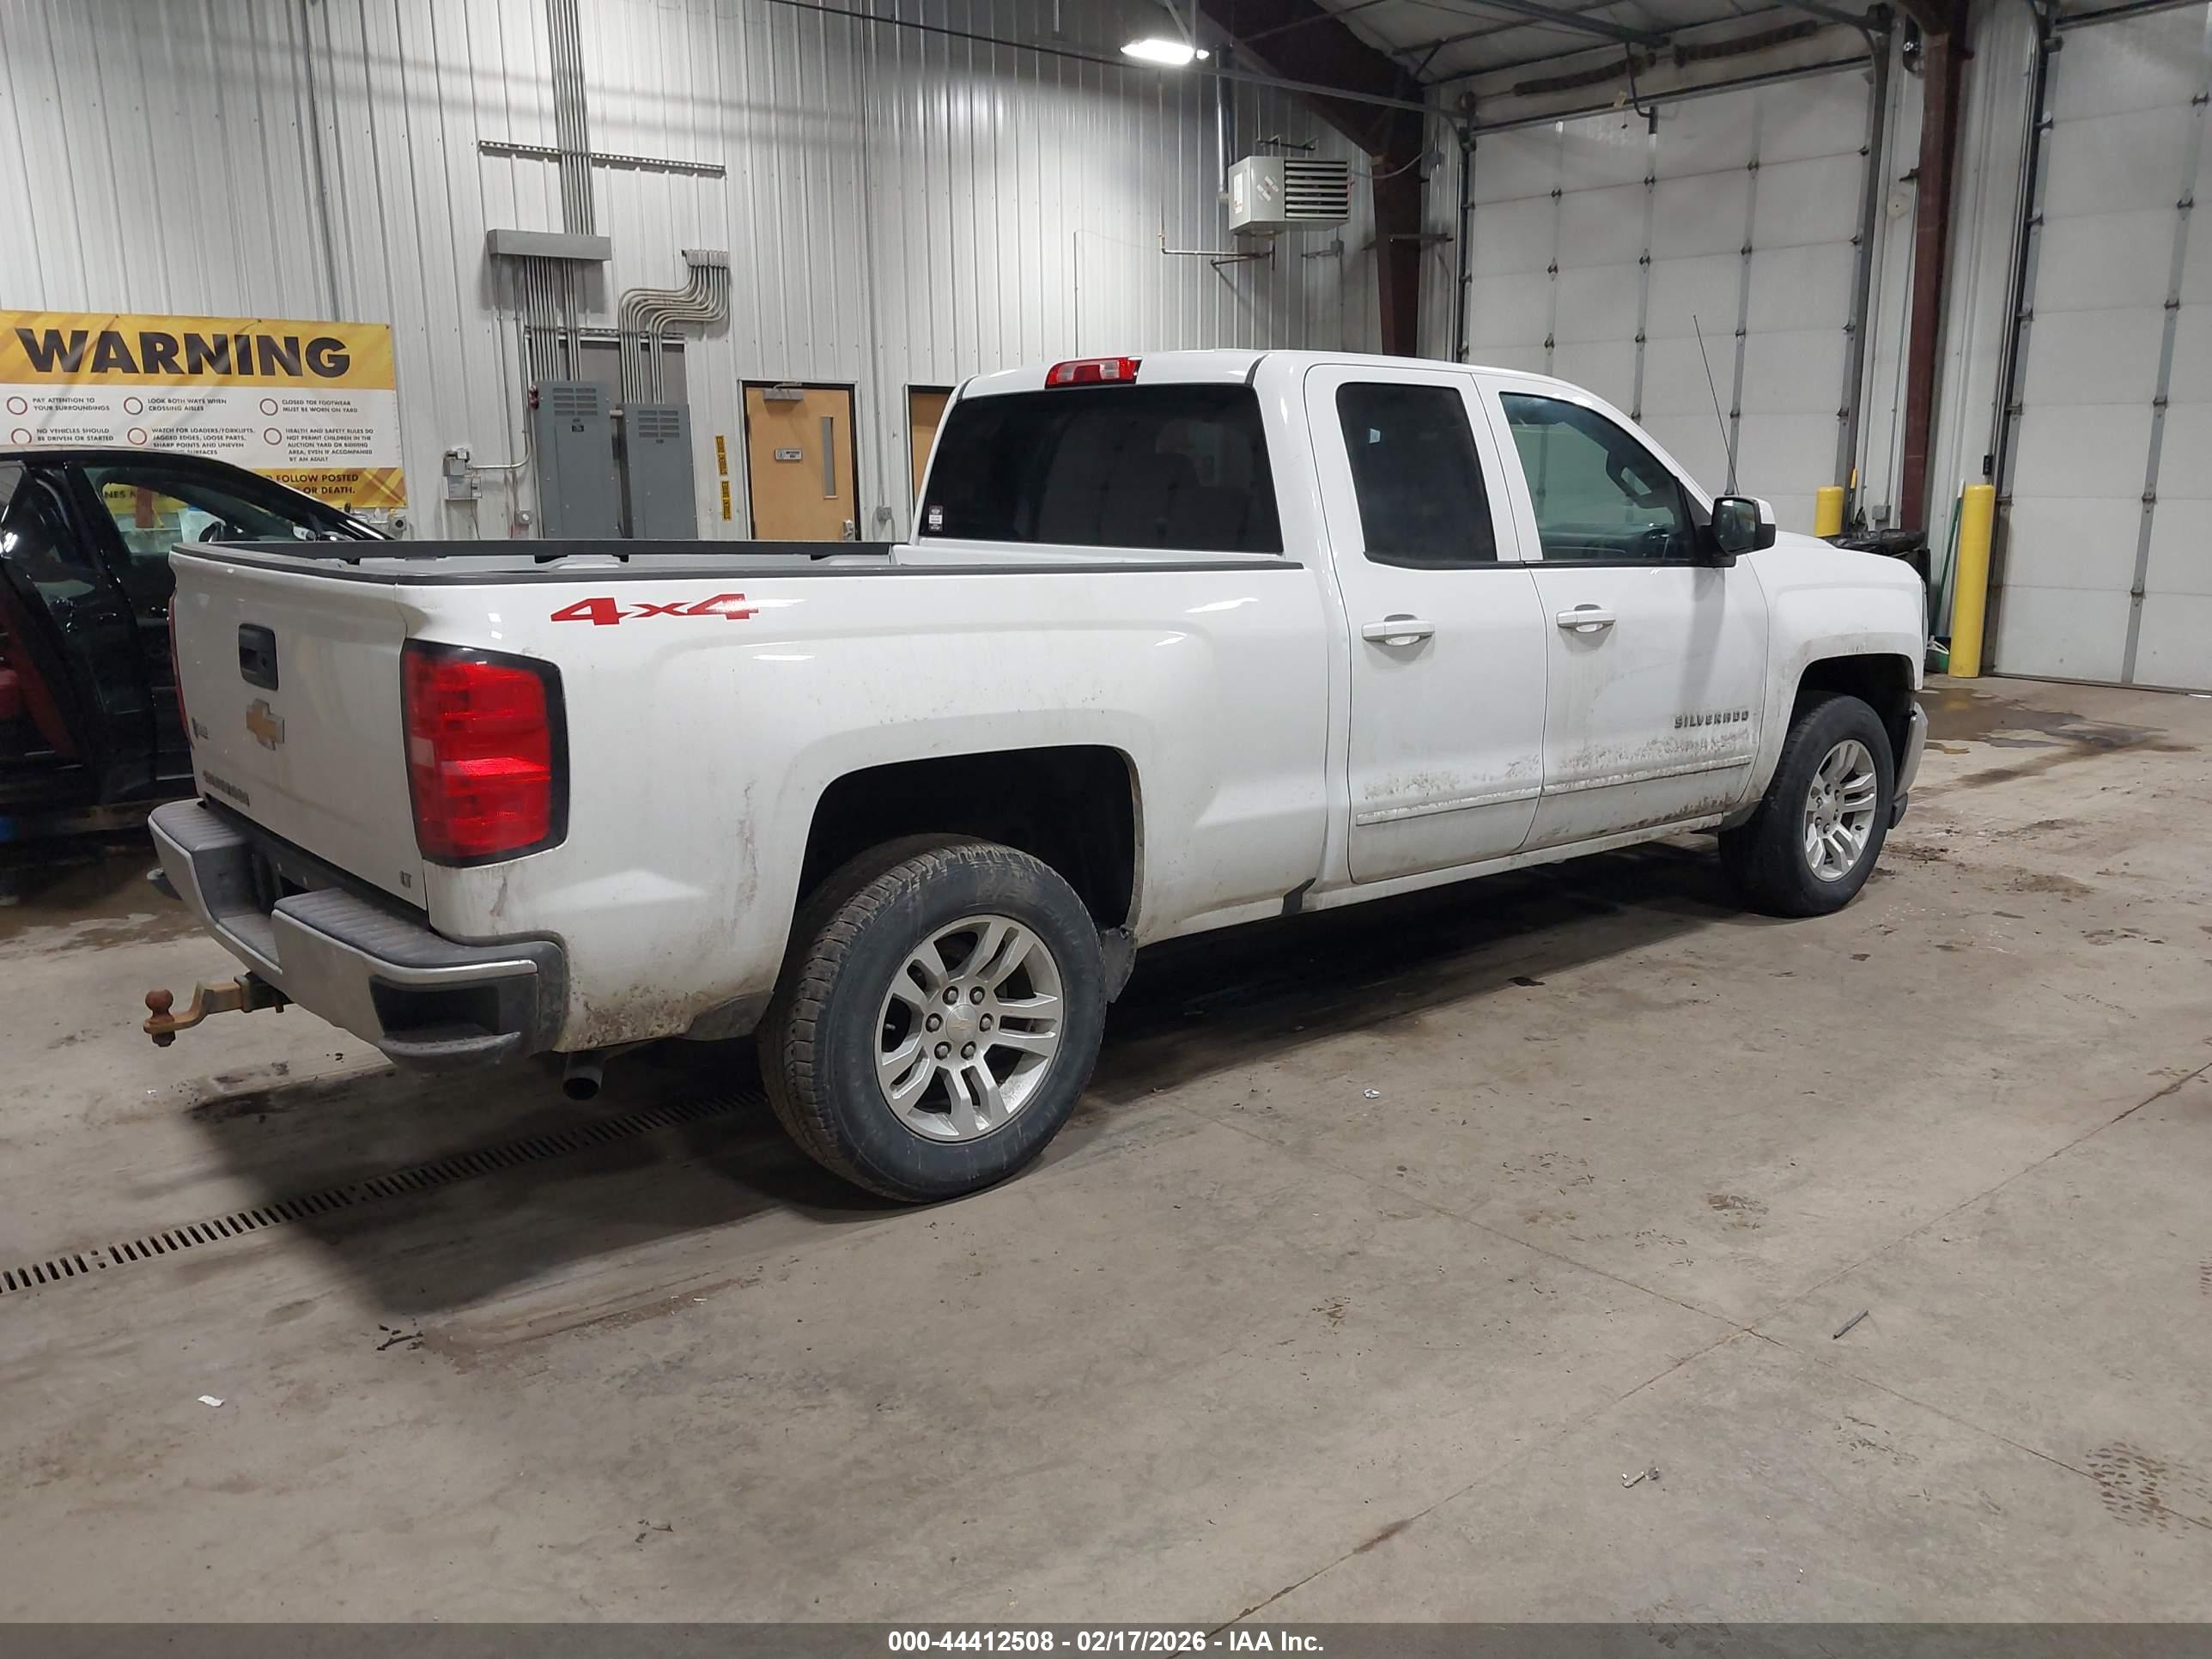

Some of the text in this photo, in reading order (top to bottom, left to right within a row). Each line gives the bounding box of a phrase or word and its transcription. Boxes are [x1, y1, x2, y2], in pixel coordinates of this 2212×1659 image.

[15, 327, 350, 378] WARNING
[277, 474, 318, 482] FOLLOW
[322, 474, 359, 482] POSTED
[1674, 710, 1749, 729] SILVERADO
